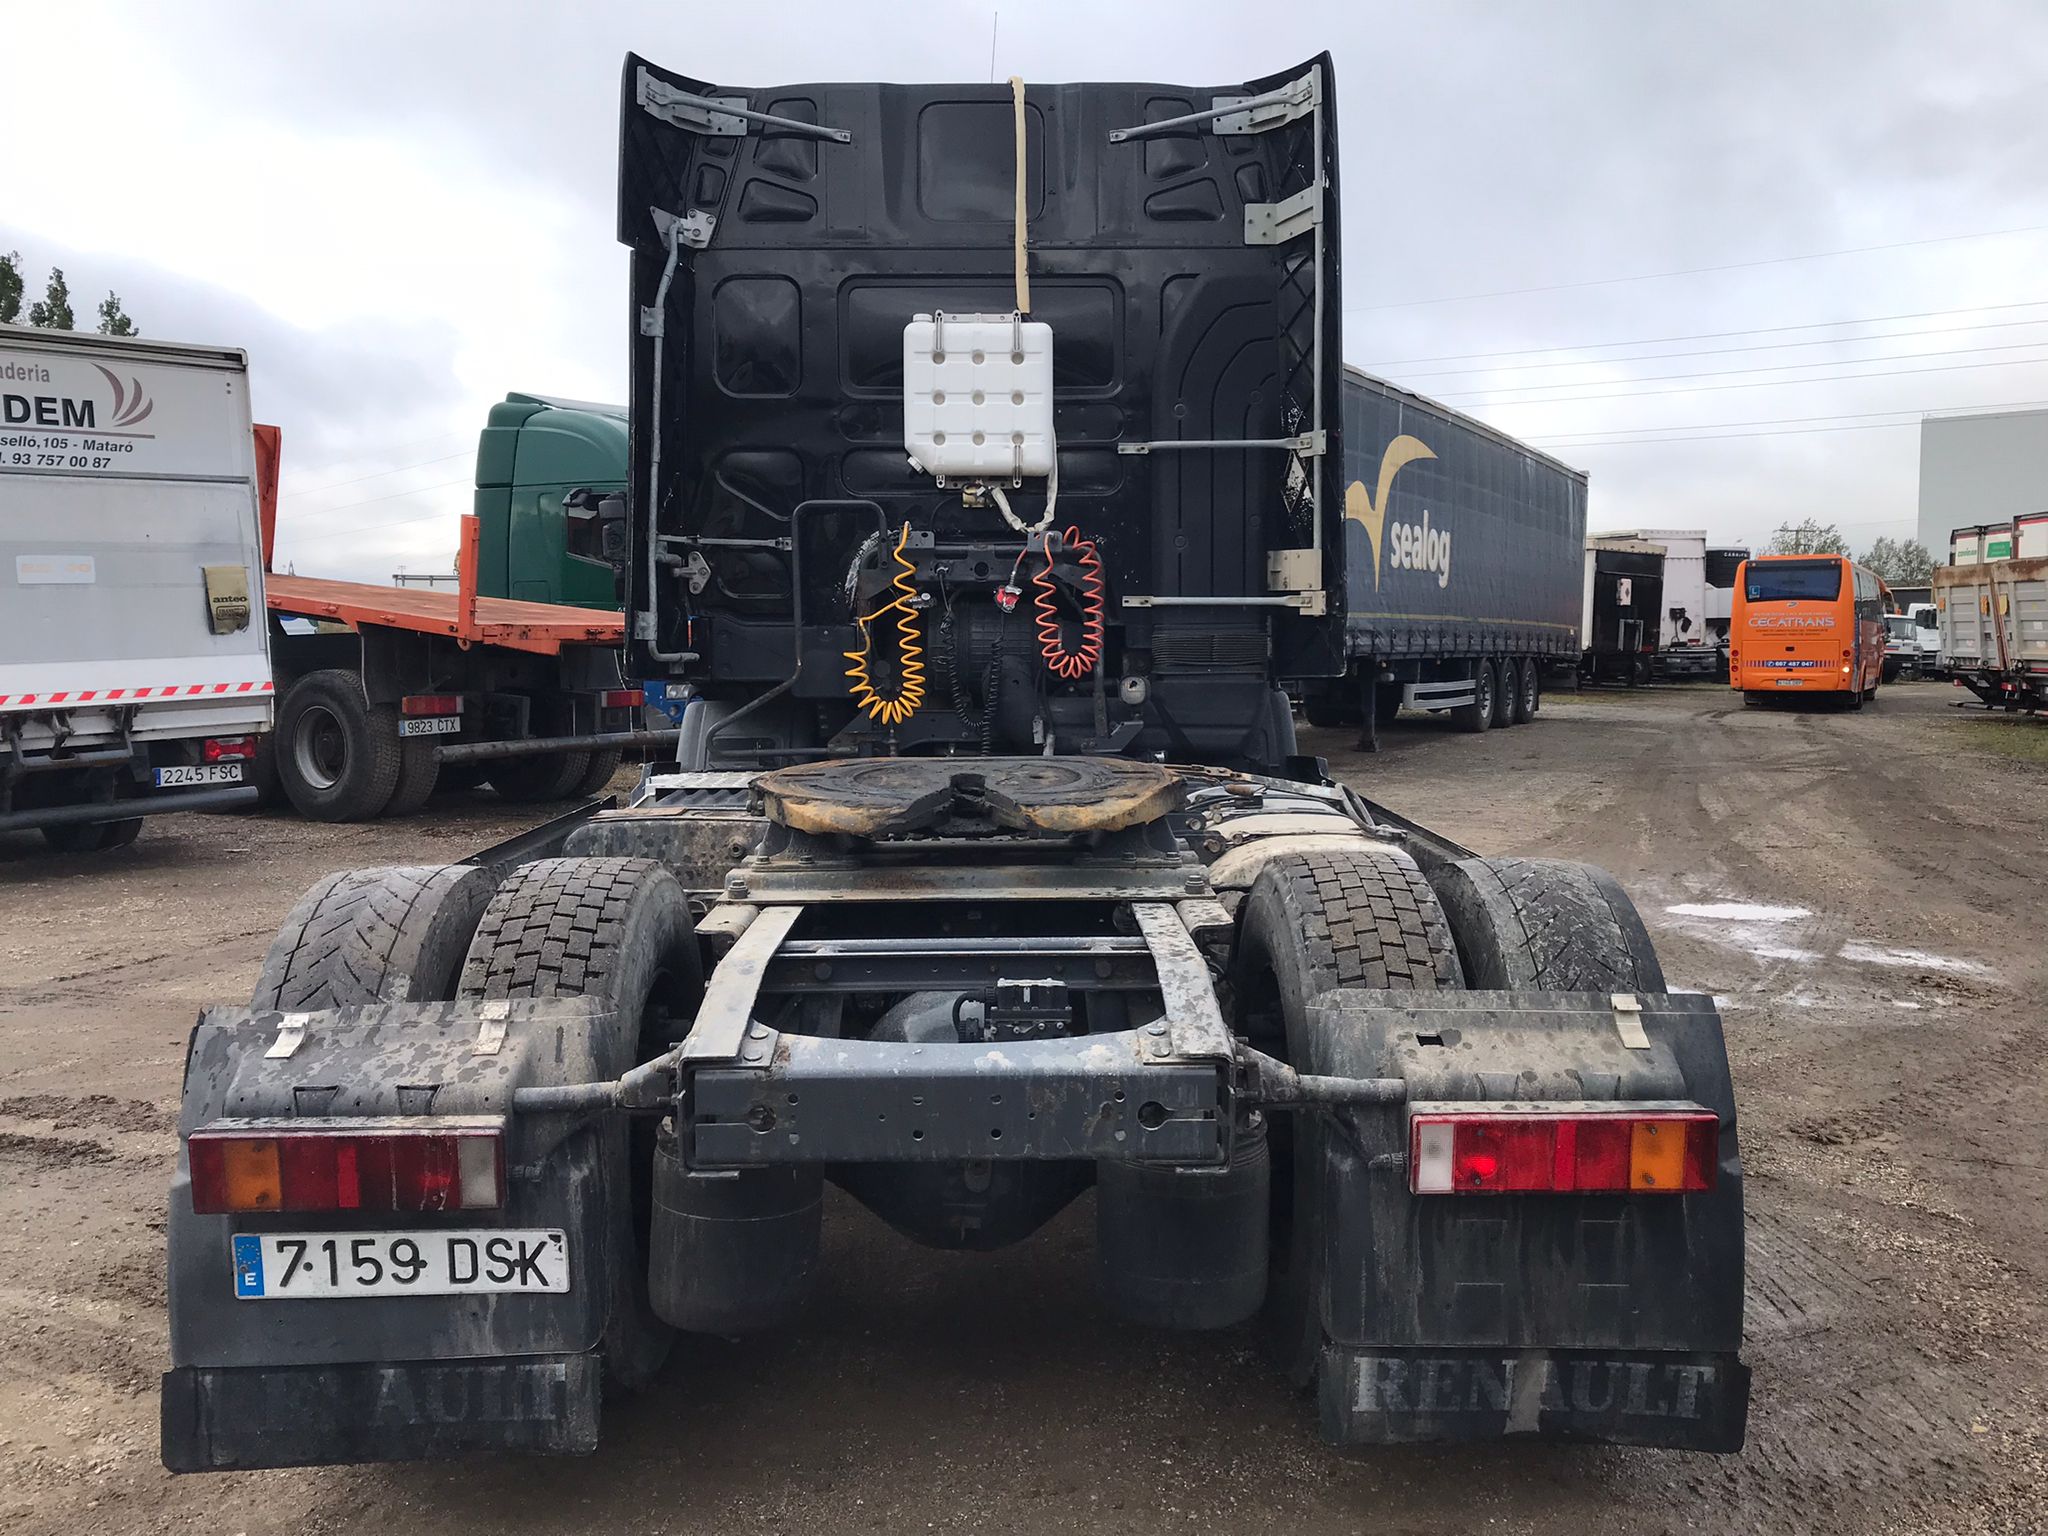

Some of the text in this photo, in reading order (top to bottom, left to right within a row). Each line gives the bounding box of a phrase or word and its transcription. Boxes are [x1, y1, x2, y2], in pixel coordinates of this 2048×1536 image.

[3, 394, 96, 429] DEM
[83, 440, 133, 453] Mataró
[12, 453, 31, 465] 93
[36, 454, 65, 467] 757
[69, 456, 88, 468] 00
[92, 457, 112, 469] 87
[1390, 509, 1451, 589] sealog
[213, 595, 248, 603] anteo
[1748, 616, 1836, 628] CECATRANS
[407, 718, 456, 734] 9823 CTX
[164, 765, 239, 784] 2245 FSC
[276, 1238, 550, 1288] 7159 DSK
[244, 1272, 257, 1287] E
[1352, 1356, 1719, 1419] RENAULT
